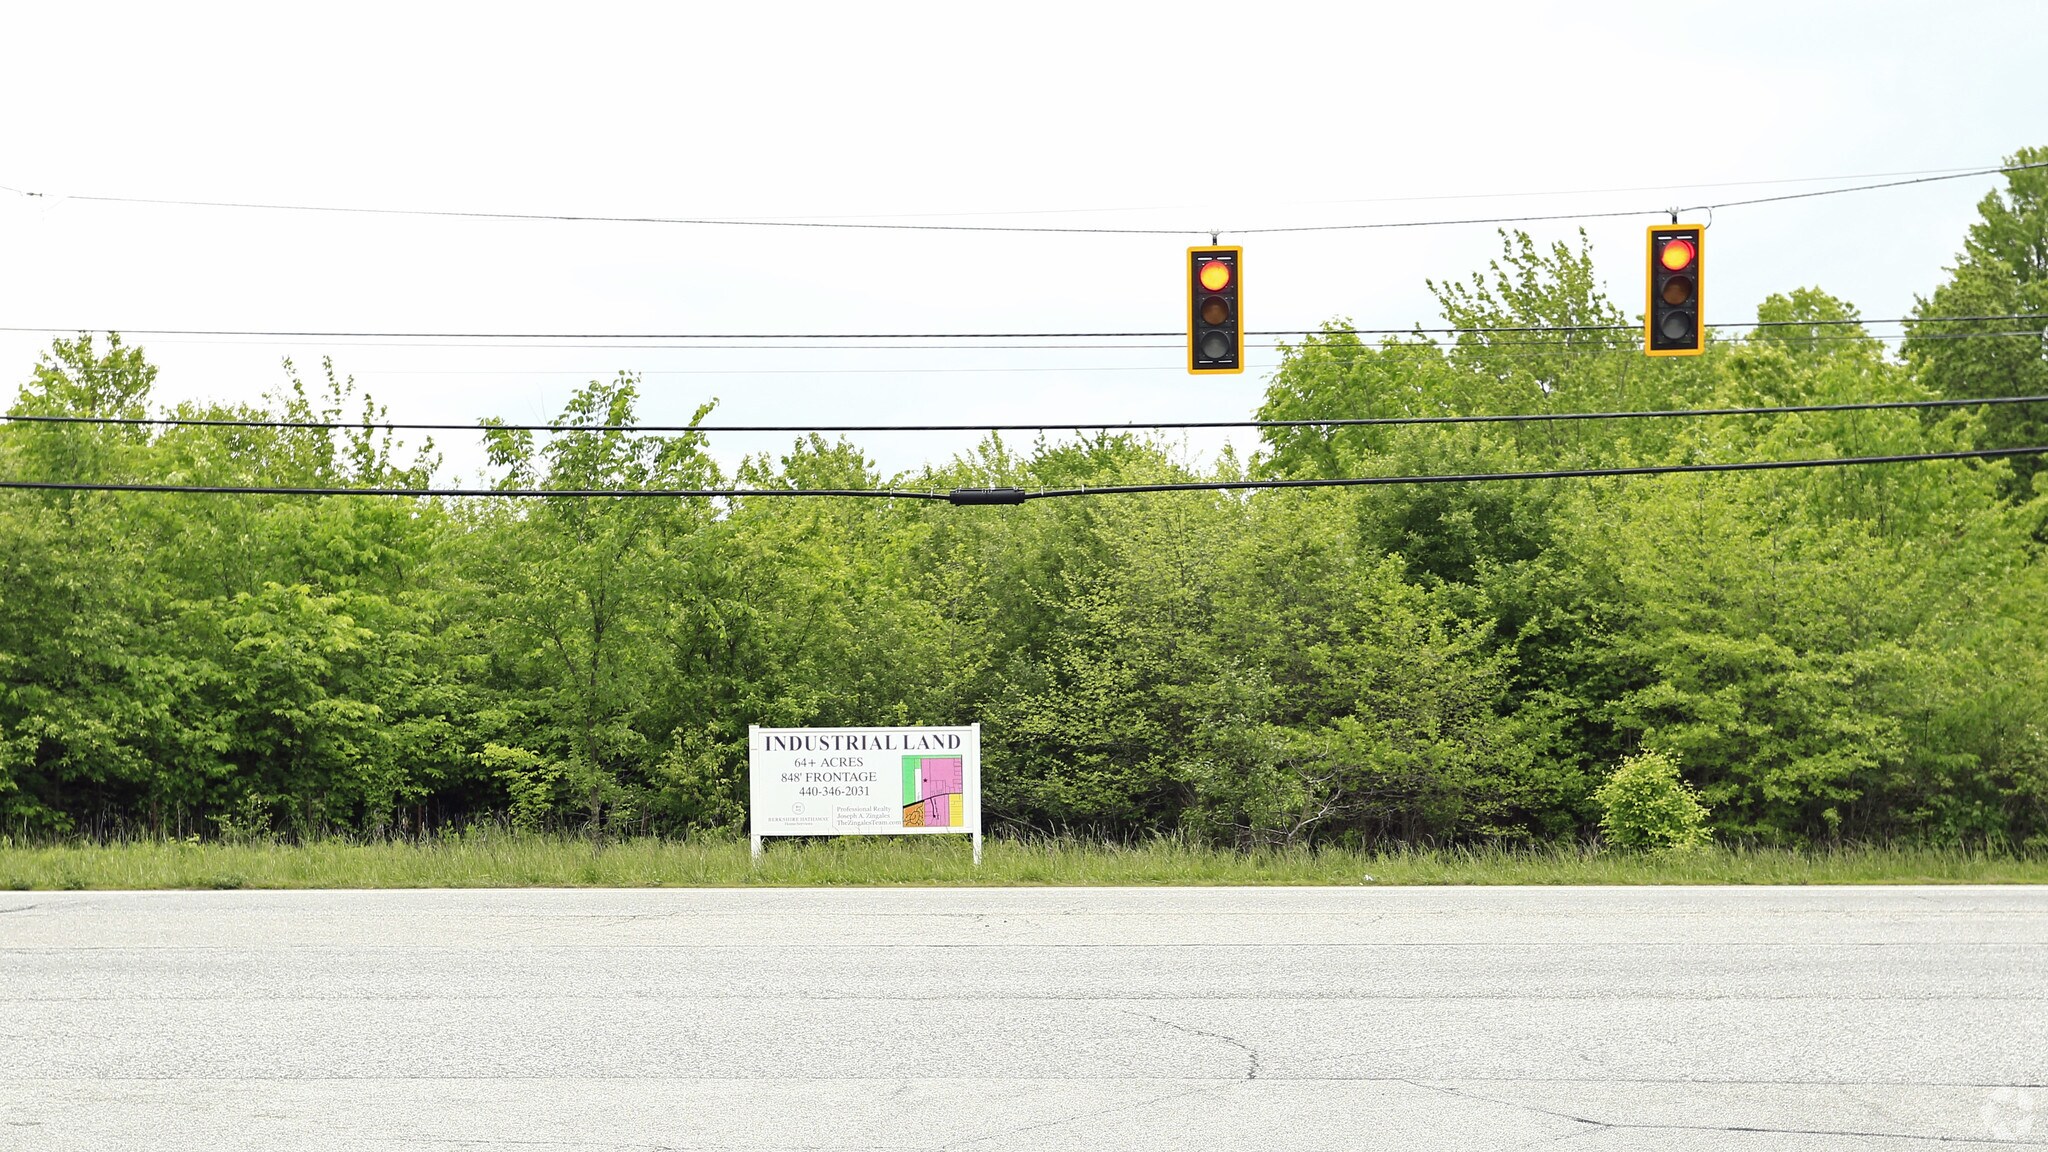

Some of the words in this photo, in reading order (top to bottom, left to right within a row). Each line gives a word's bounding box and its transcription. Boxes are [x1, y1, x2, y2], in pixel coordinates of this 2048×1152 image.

[765, 734, 897, 752] INDUSTRIAL
[903, 734, 961, 750] LAND
[794, 757, 816, 768] 64+
[820, 757, 864, 768] ACRES
[781, 772, 802, 783] 848'
[806, 771, 878, 783] FRONTAGE
[799, 785, 870, 797] 440-346-2031
[873, 805, 891, 814] Realty
[836, 812, 858, 820] Joseph
[865, 812, 891, 820] Zingales
[837, 819, 902, 827] TheZingalesTeam.com
